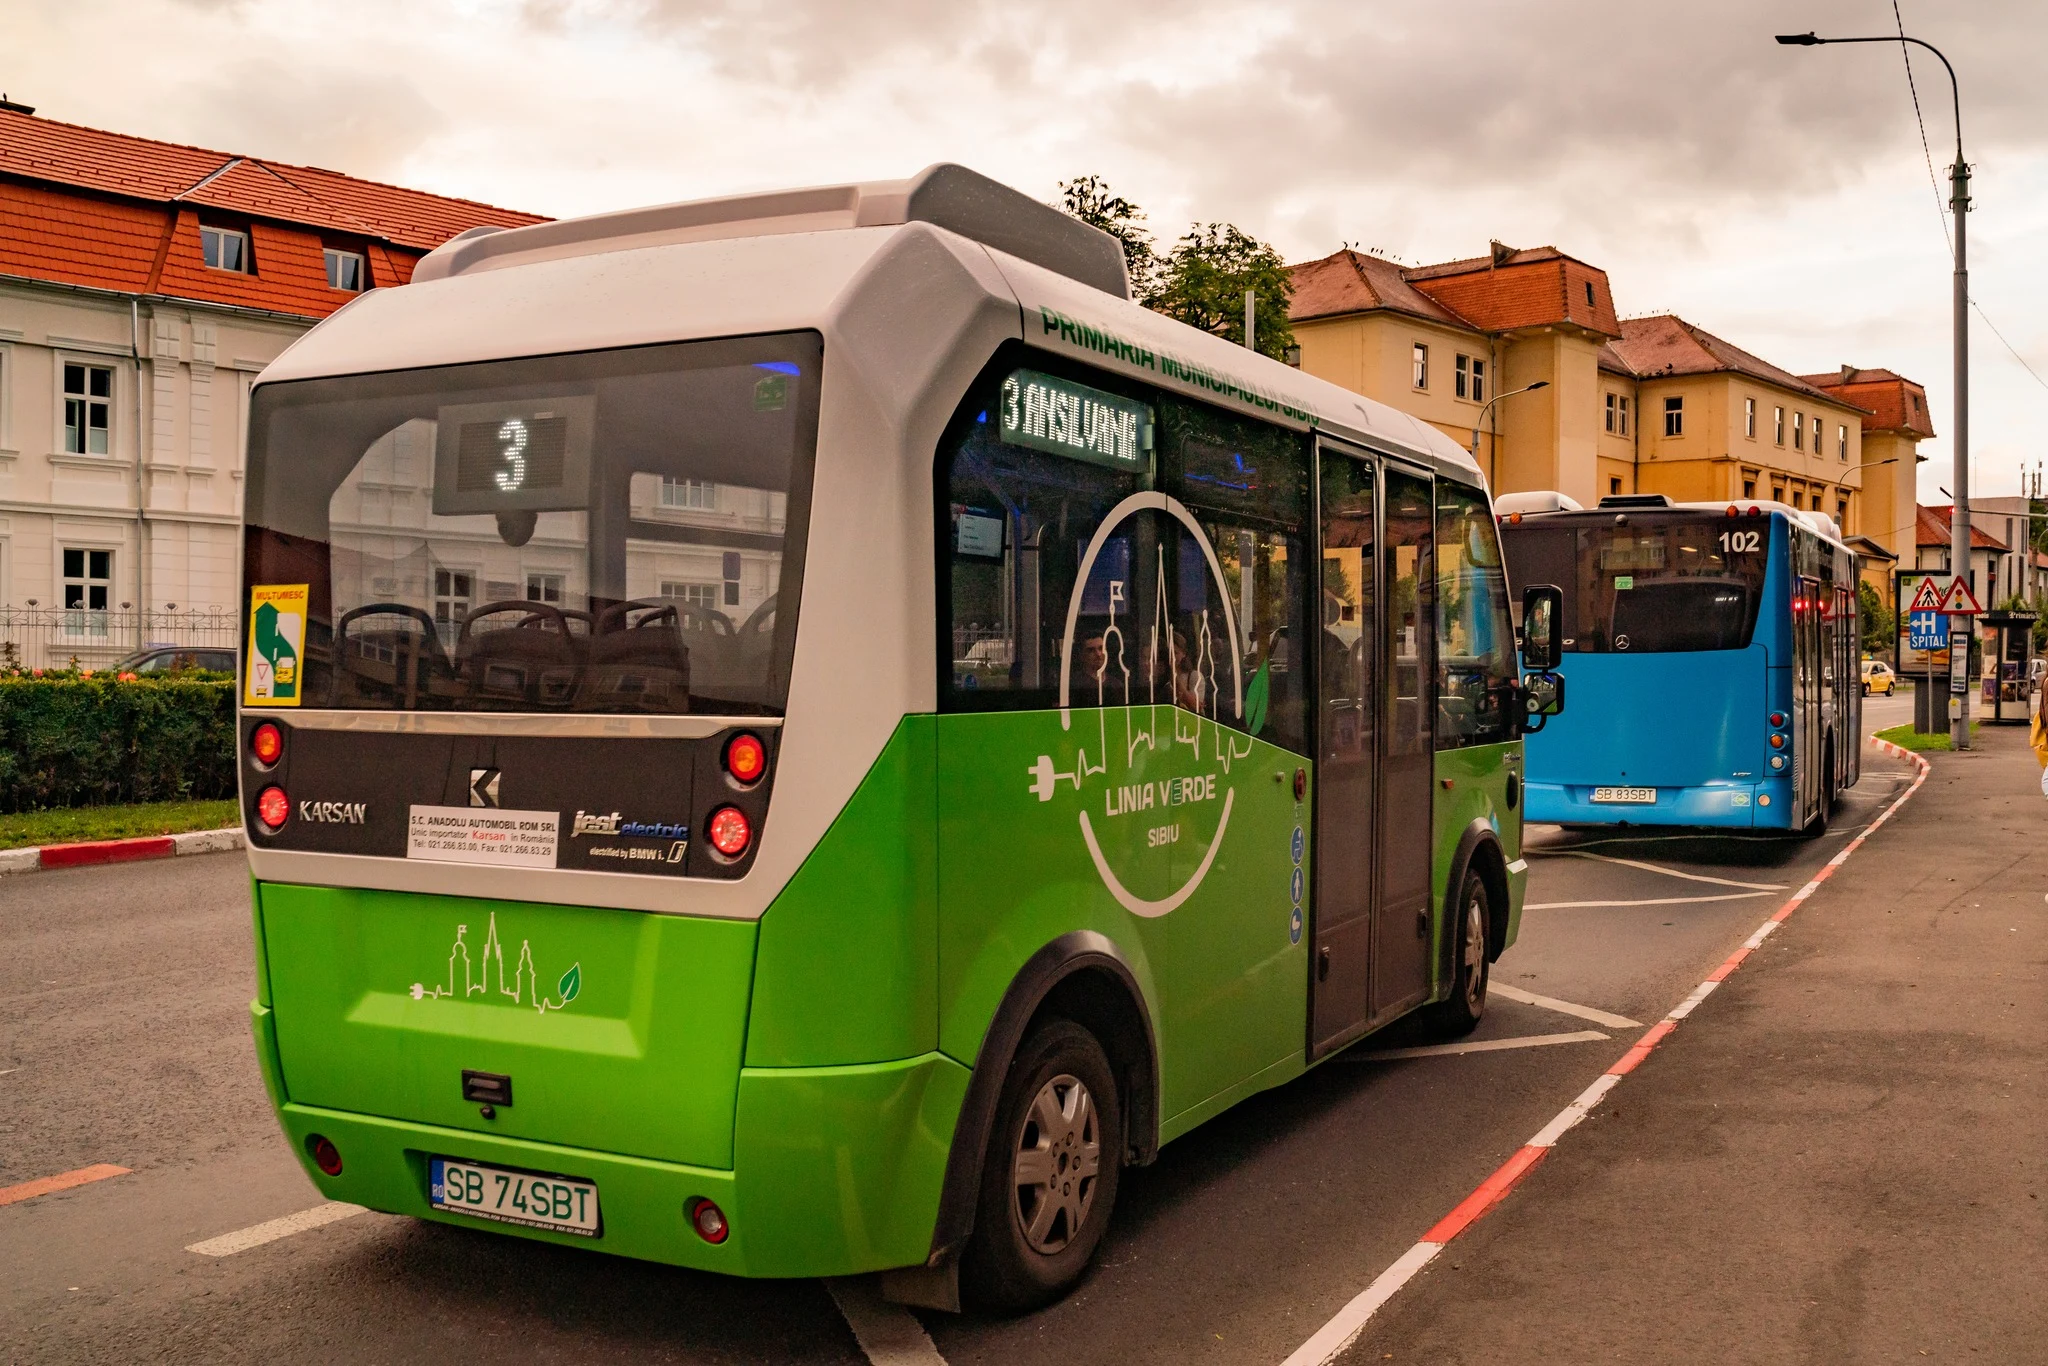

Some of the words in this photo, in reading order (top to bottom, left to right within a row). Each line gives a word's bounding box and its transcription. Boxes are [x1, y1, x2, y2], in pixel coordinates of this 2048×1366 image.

[1004, 377, 1019, 430] 3
[496, 419, 527, 491] 3
[1718, 531, 1760, 553] 102
[1920, 612, 1936, 635] H
[1911, 635, 1946, 648] SPITAL
[1105, 782, 1154, 817] LINIA
[1159, 774, 1216, 807] VERDE
[1596, 788, 1613, 800] SB
[1616, 789, 1654, 801] 83SBT
[300, 800, 367, 825] KARSAN
[411, 815, 426, 825] S.C.
[428, 816, 467, 828] ANADOLU
[469, 818, 518, 831] AUTOMOBIL
[519, 821, 539, 832] ROM
[540, 822, 556, 832] SRL
[570, 810, 623, 838] jest
[621, 821, 689, 838] electric
[410, 827, 428, 837] Unic
[429, 828, 468, 840] importator
[472, 829, 506, 842] Karsan
[1147, 823, 1180, 848] SIBIU
[629, 848, 658, 860] BMW
[431, 1183, 445, 1199] RO
[446, 1167, 484, 1206] SB
[494, 1174, 591, 1223] 74SBT
